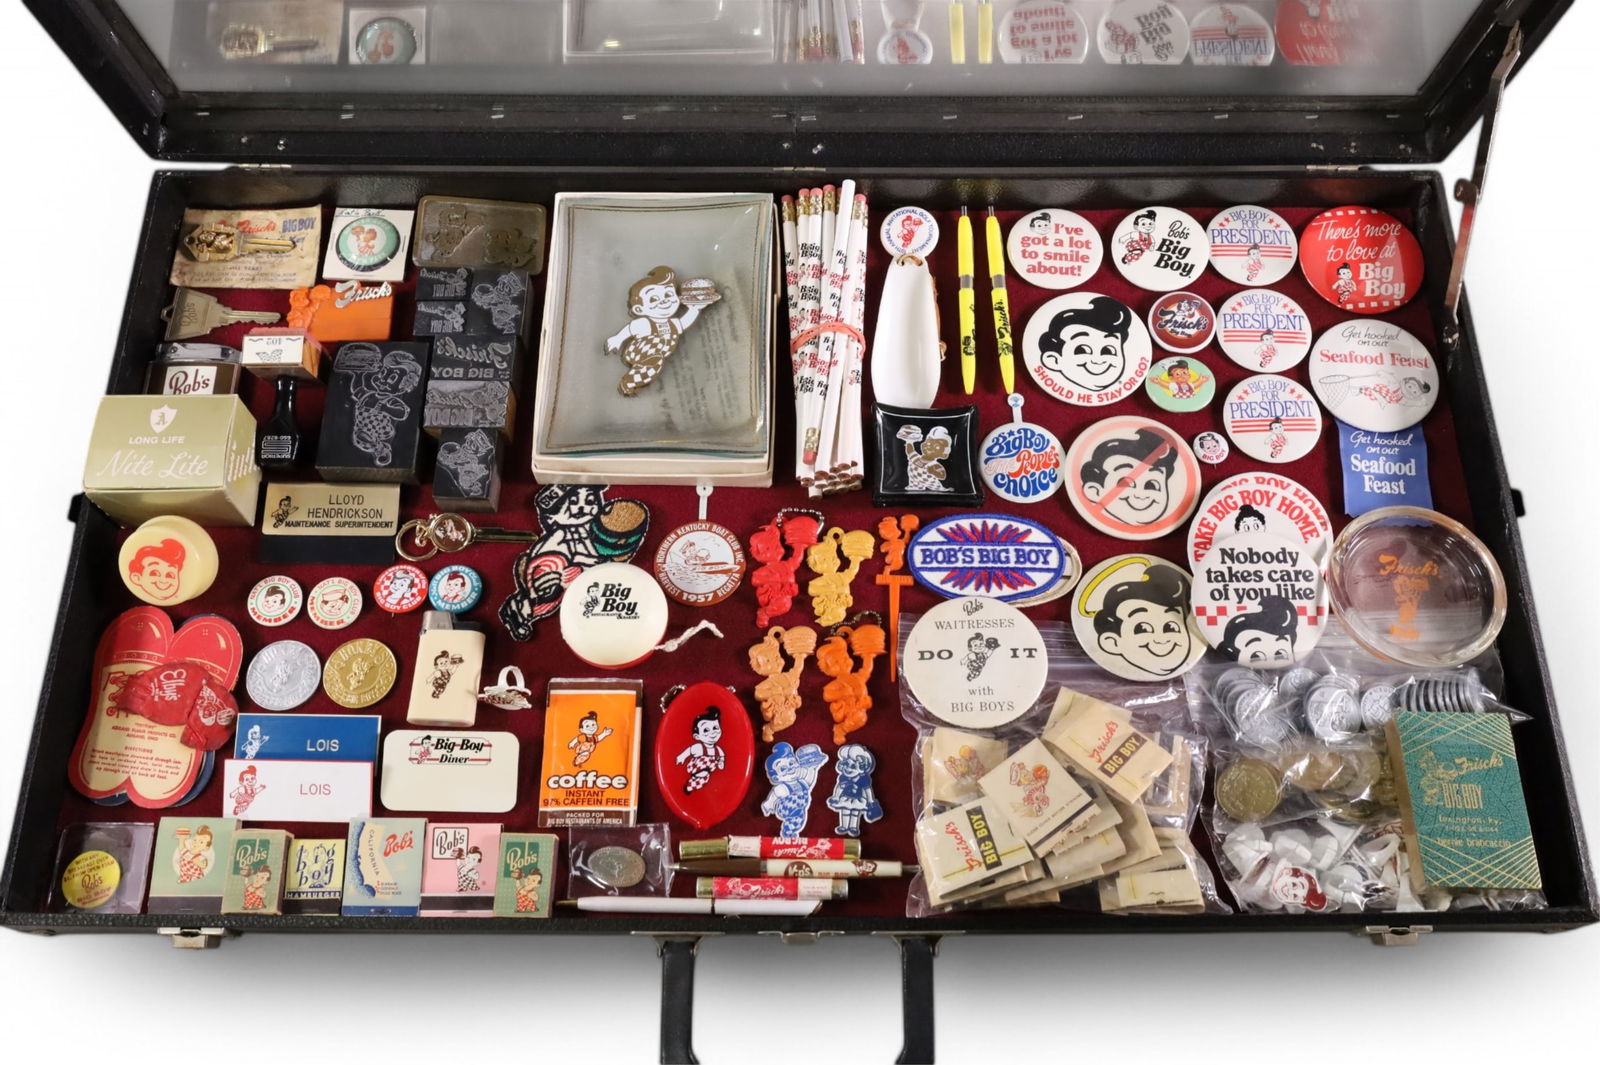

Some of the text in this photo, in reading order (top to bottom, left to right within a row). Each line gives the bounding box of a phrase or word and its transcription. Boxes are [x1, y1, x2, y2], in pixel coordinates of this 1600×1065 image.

[1230, 210, 1270, 221] BIG BOY
[1242, 220, 1259, 229] FOR
[281, 217, 317, 233] BIG BOY
[1054, 223, 1084, 235] I've
[1168, 220, 1190, 239] Bob's
[1312, 219, 1402, 241] There's more
[1020, 235, 1092, 250] got a lot
[1211, 228, 1290, 246] PRESIDENT
[1021, 248, 1090, 263] to smile
[1156, 237, 1191, 260] Big
[1327, 241, 1396, 262] to love at
[1026, 261, 1082, 276] about!
[1153, 253, 1196, 277] Boy
[1359, 262, 1393, 281] Big
[335, 280, 393, 309] Frisch's
[1365, 280, 1406, 299] Boy
[1241, 294, 1283, 306] BIG BOY
[1254, 304, 1272, 313] FOR
[1157, 308, 1208, 330] Frisch's
[1223, 313, 1304, 331] PRESIDENT
[1341, 326, 1402, 343] Get hooked
[1319, 350, 1430, 369] Seafood Feast
[1034, 356, 1150, 403] SHOULD HE STAY OR GO?
[1248, 380, 1290, 393] BIG BOY
[1261, 391, 1280, 400] FOR
[1229, 400, 1313, 419] PRESIDENT
[129, 436, 185, 445] LONG LIFE
[1350, 430, 1414, 448] Get hooked
[1366, 446, 1399, 455] on our
[97, 449, 209, 479] Nite Lite
[1351, 454, 1416, 476] Seafood
[1363, 474, 1406, 494] Feast
[328, 494, 365, 505] LLOYD
[307, 508, 383, 519] HENDRICKSON
[335, 521, 394, 529] SUPERINTENDENT
[1194, 489, 1277, 562] TAKE BIG BOY
[656, 523, 741, 563] NORTHERN KENTUCKY BOAT CLUB
[920, 546, 1052, 565] BOB'S BIG BOY
[1219, 547, 1299, 567] Nobody
[451, 565, 468, 573] BOY
[1378, 554, 1441, 576] Frisch's
[1206, 566, 1314, 583] takes care
[264, 577, 300, 599] BIG BOY CLUB
[600, 583, 632, 601] Big
[658, 573, 741, 602] HARVEST 1957 REGATTA
[1210, 584, 1316, 604] of you like
[385, 602, 401, 610] BOY
[403, 596, 422, 609] CLUB
[437, 591, 478, 610] MEMBER
[601, 598, 638, 615] Boy
[963, 599, 984, 616] Bob's
[250, 606, 296, 623] MEMBER
[309, 595, 346, 626] MEMBER
[934, 618, 1015, 630] WAITRESSES
[918, 648, 1038, 661] DO IT
[968, 686, 994, 696] with
[951, 701, 1015, 713] BIG BOYS
[306, 739, 339, 751] LOIS
[1088, 720, 1119, 763] Frisch's
[439, 754, 469, 763] Diner
[1103, 737, 1141, 773] BIG BOY
[1455, 751, 1504, 775] Frisch's
[547, 770, 628, 789] coffee
[300, 783, 331, 795] LOIS
[565, 790, 605, 798] INSTANT
[1442, 783, 1484, 809] BIG BOY
[563, 798, 602, 806] CAFFEIN
[606, 798, 629, 806] FREE
[384, 830, 414, 857] Bob's
[436, 828, 465, 855] Bob's
[970, 814, 998, 865] BIG BOY
[236, 839, 268, 868] Bob's
[368, 829, 381, 876] CALIFORNIA
[507, 841, 538, 870] Bob's
[750, 884, 784, 896] Frisch's
